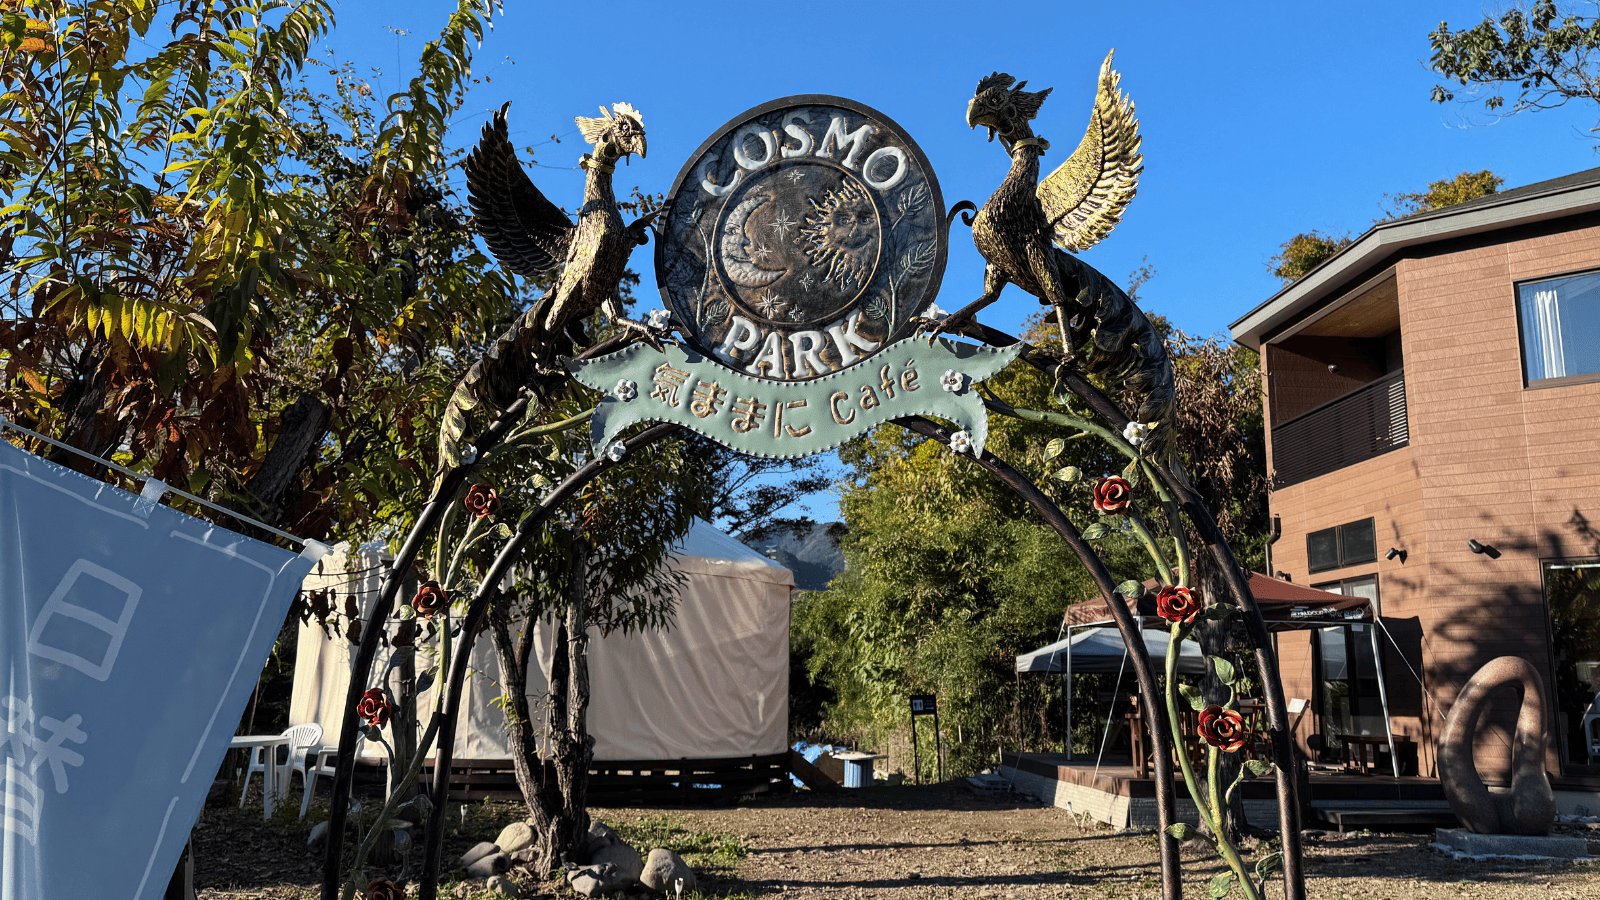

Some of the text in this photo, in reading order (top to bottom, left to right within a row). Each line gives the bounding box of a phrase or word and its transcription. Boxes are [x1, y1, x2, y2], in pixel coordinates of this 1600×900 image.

[697, 110, 909, 196] COSMO
[713, 308, 880, 379] PARK
[650, 359, 920, 438] 気ままに Café
